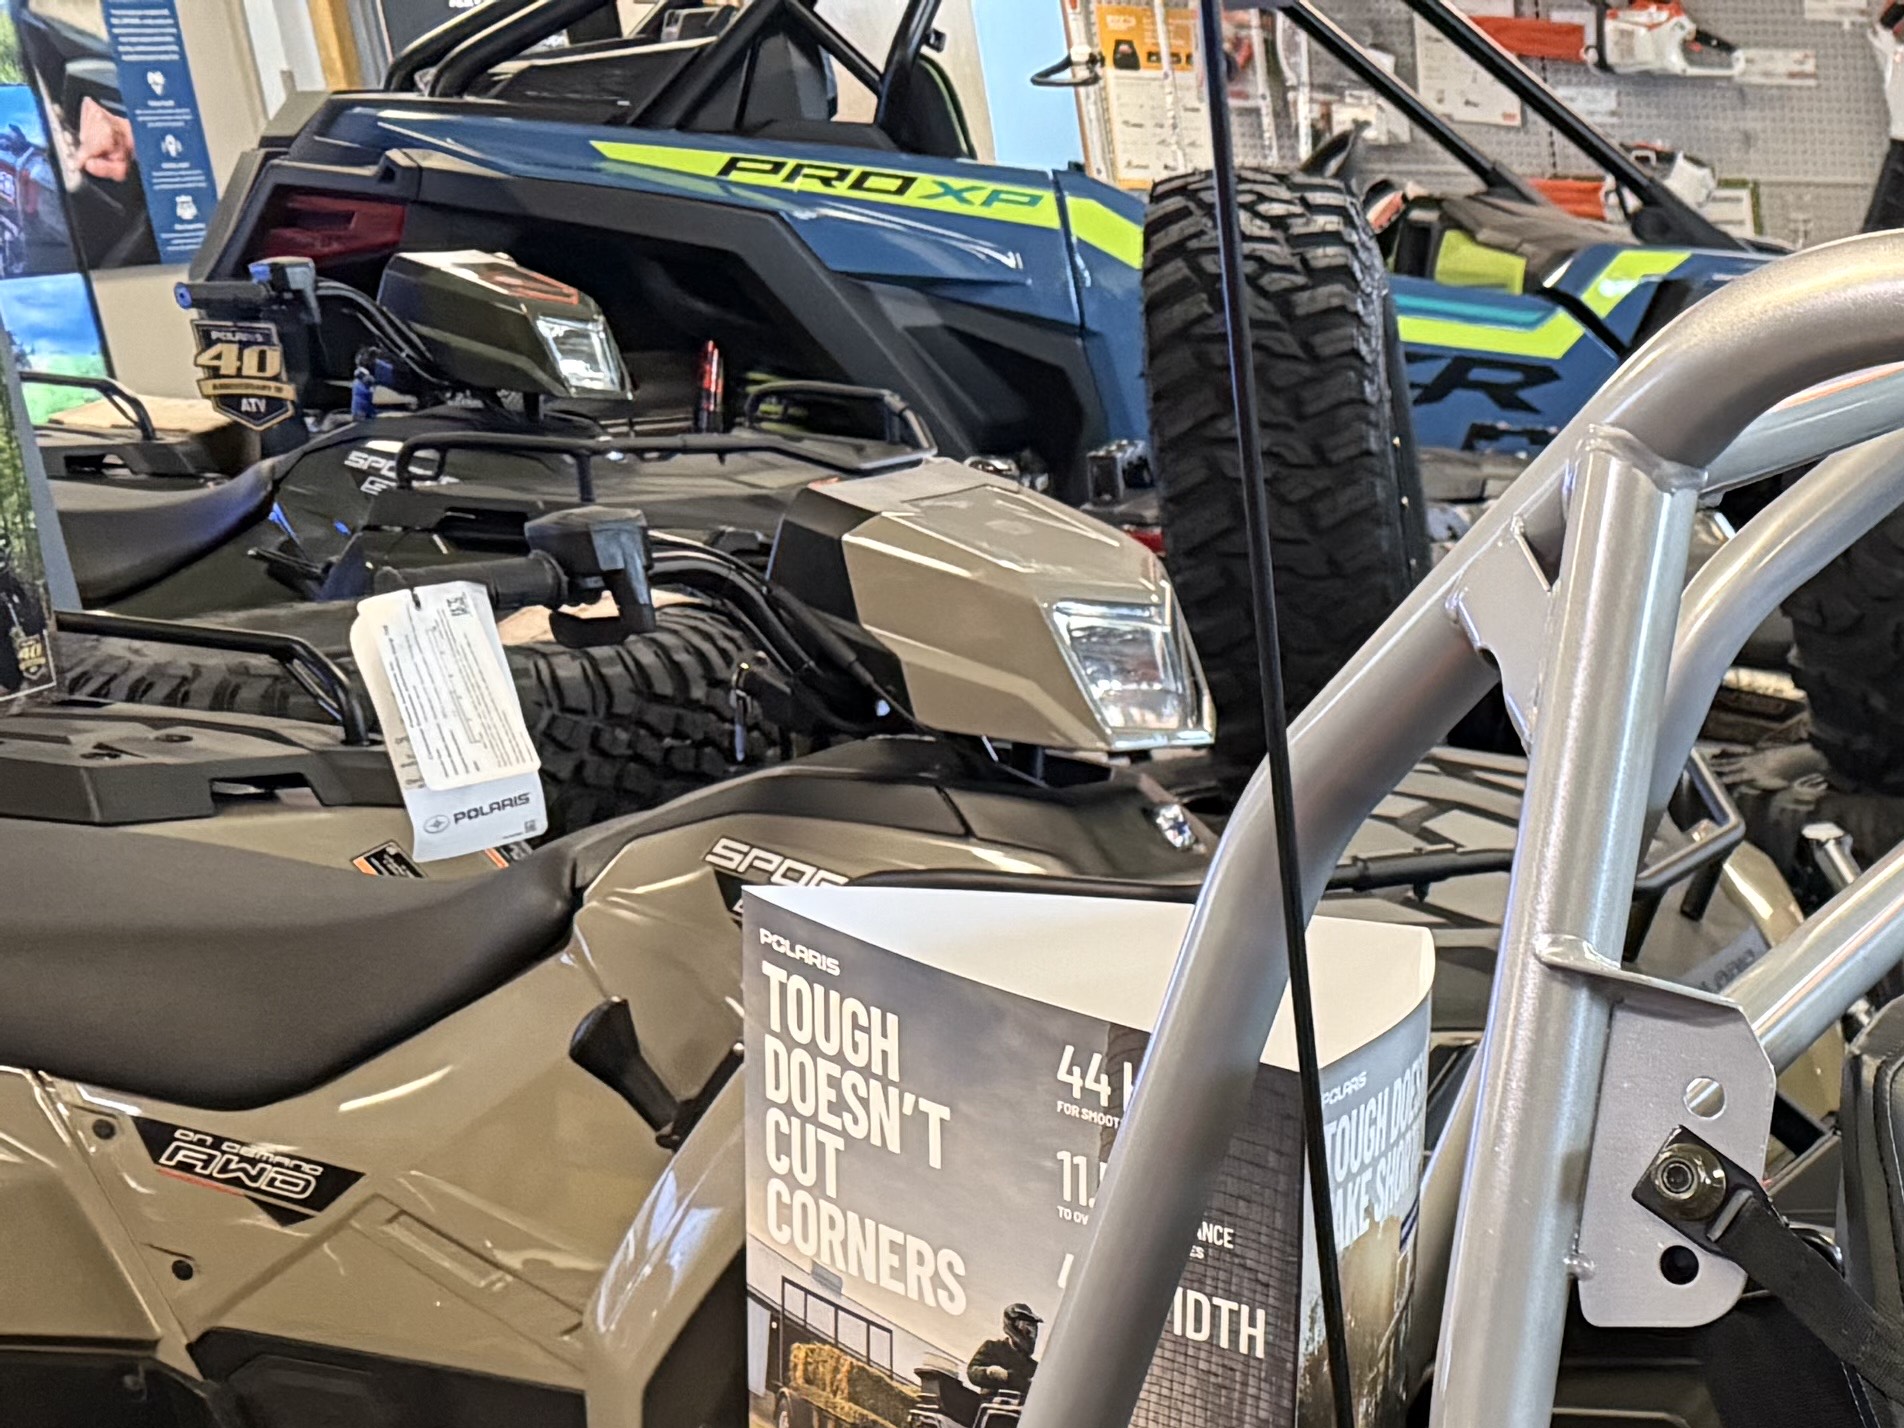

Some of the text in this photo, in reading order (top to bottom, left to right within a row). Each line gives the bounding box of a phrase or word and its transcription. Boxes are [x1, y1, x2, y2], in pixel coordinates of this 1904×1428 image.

[717, 156, 1045, 209] PRO XP
[195, 342, 284, 378] 40
[240, 397, 267, 413] ATV
[453, 792, 532, 825] POLARIS
[759, 928, 841, 977] POLARIS
[761, 960, 901, 1083] TOUGH
[764, 1034, 951, 1170] DOESN'T
[1056, 1045, 1112, 1108] 44
[1057, 1100, 1081, 1118] FOR
[1324, 1086, 1390, 1183] TOUGH
[159, 1141, 316, 1199] AWD
[764, 1107, 845, 1199] CUT
[1057, 1205, 1071, 1221] TO
[765, 1177, 968, 1317] CORNERS
